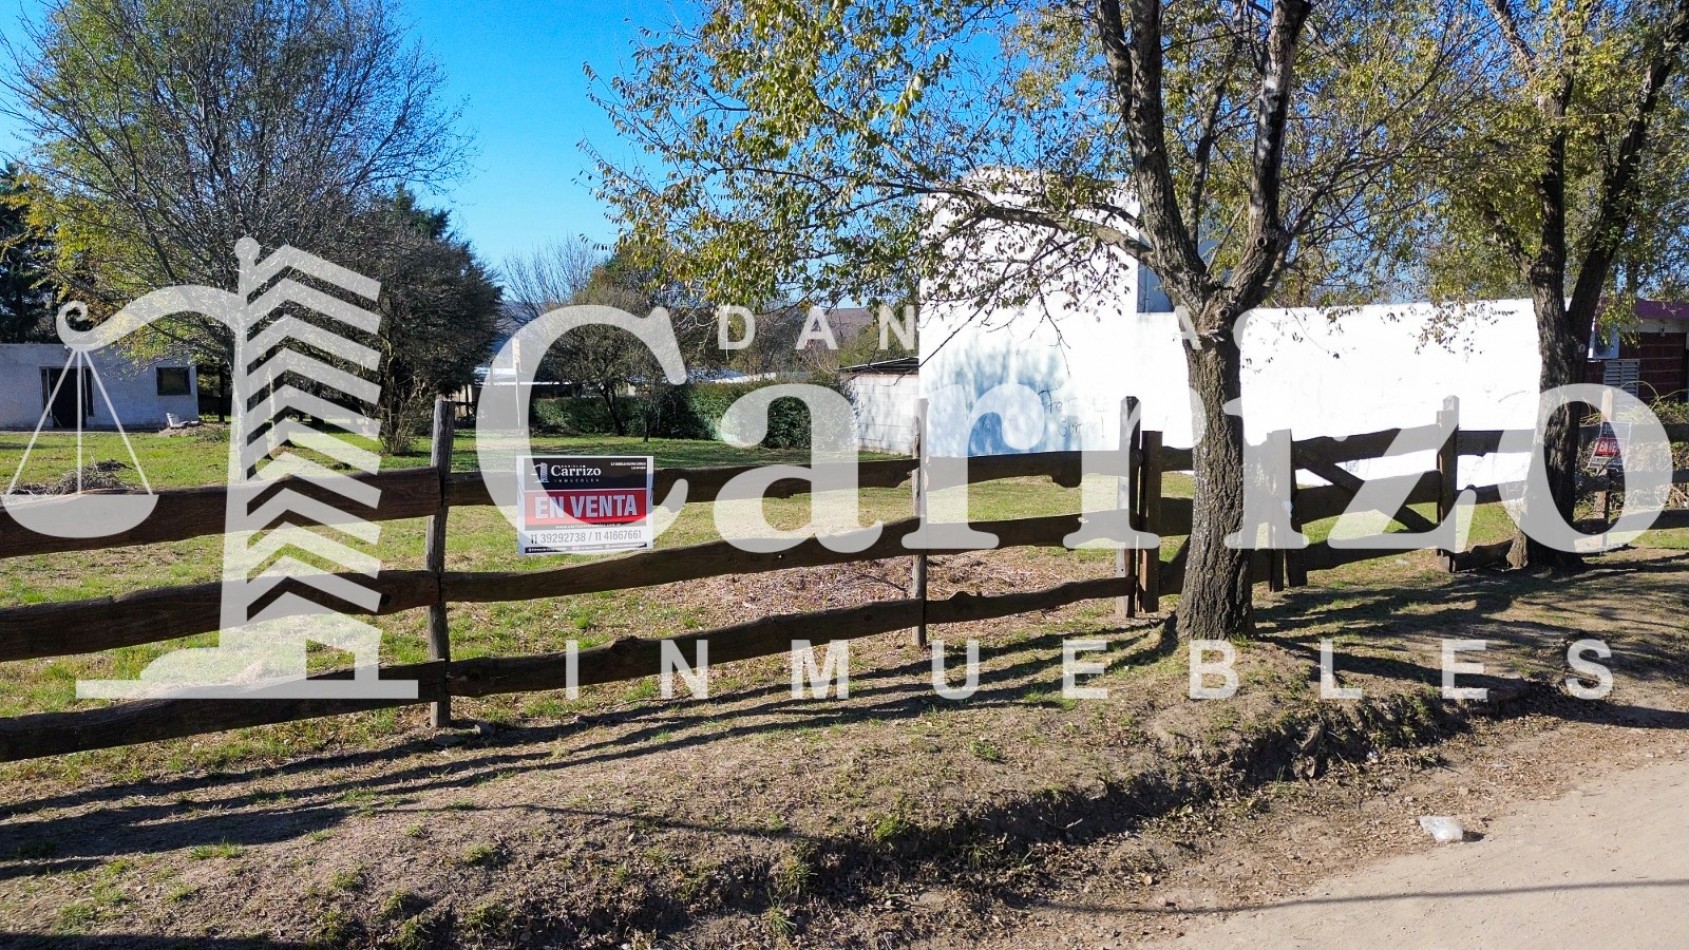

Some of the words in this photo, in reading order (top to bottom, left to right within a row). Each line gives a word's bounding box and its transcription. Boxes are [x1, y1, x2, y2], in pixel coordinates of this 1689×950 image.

[551, 465, 601, 476] Carrizo
[534, 496, 565, 519] EN
[570, 494, 638, 518] VENTA
[530, 533, 538, 544] 11
[540, 532, 586, 544] 39292738
[595, 531, 602, 541] 11
